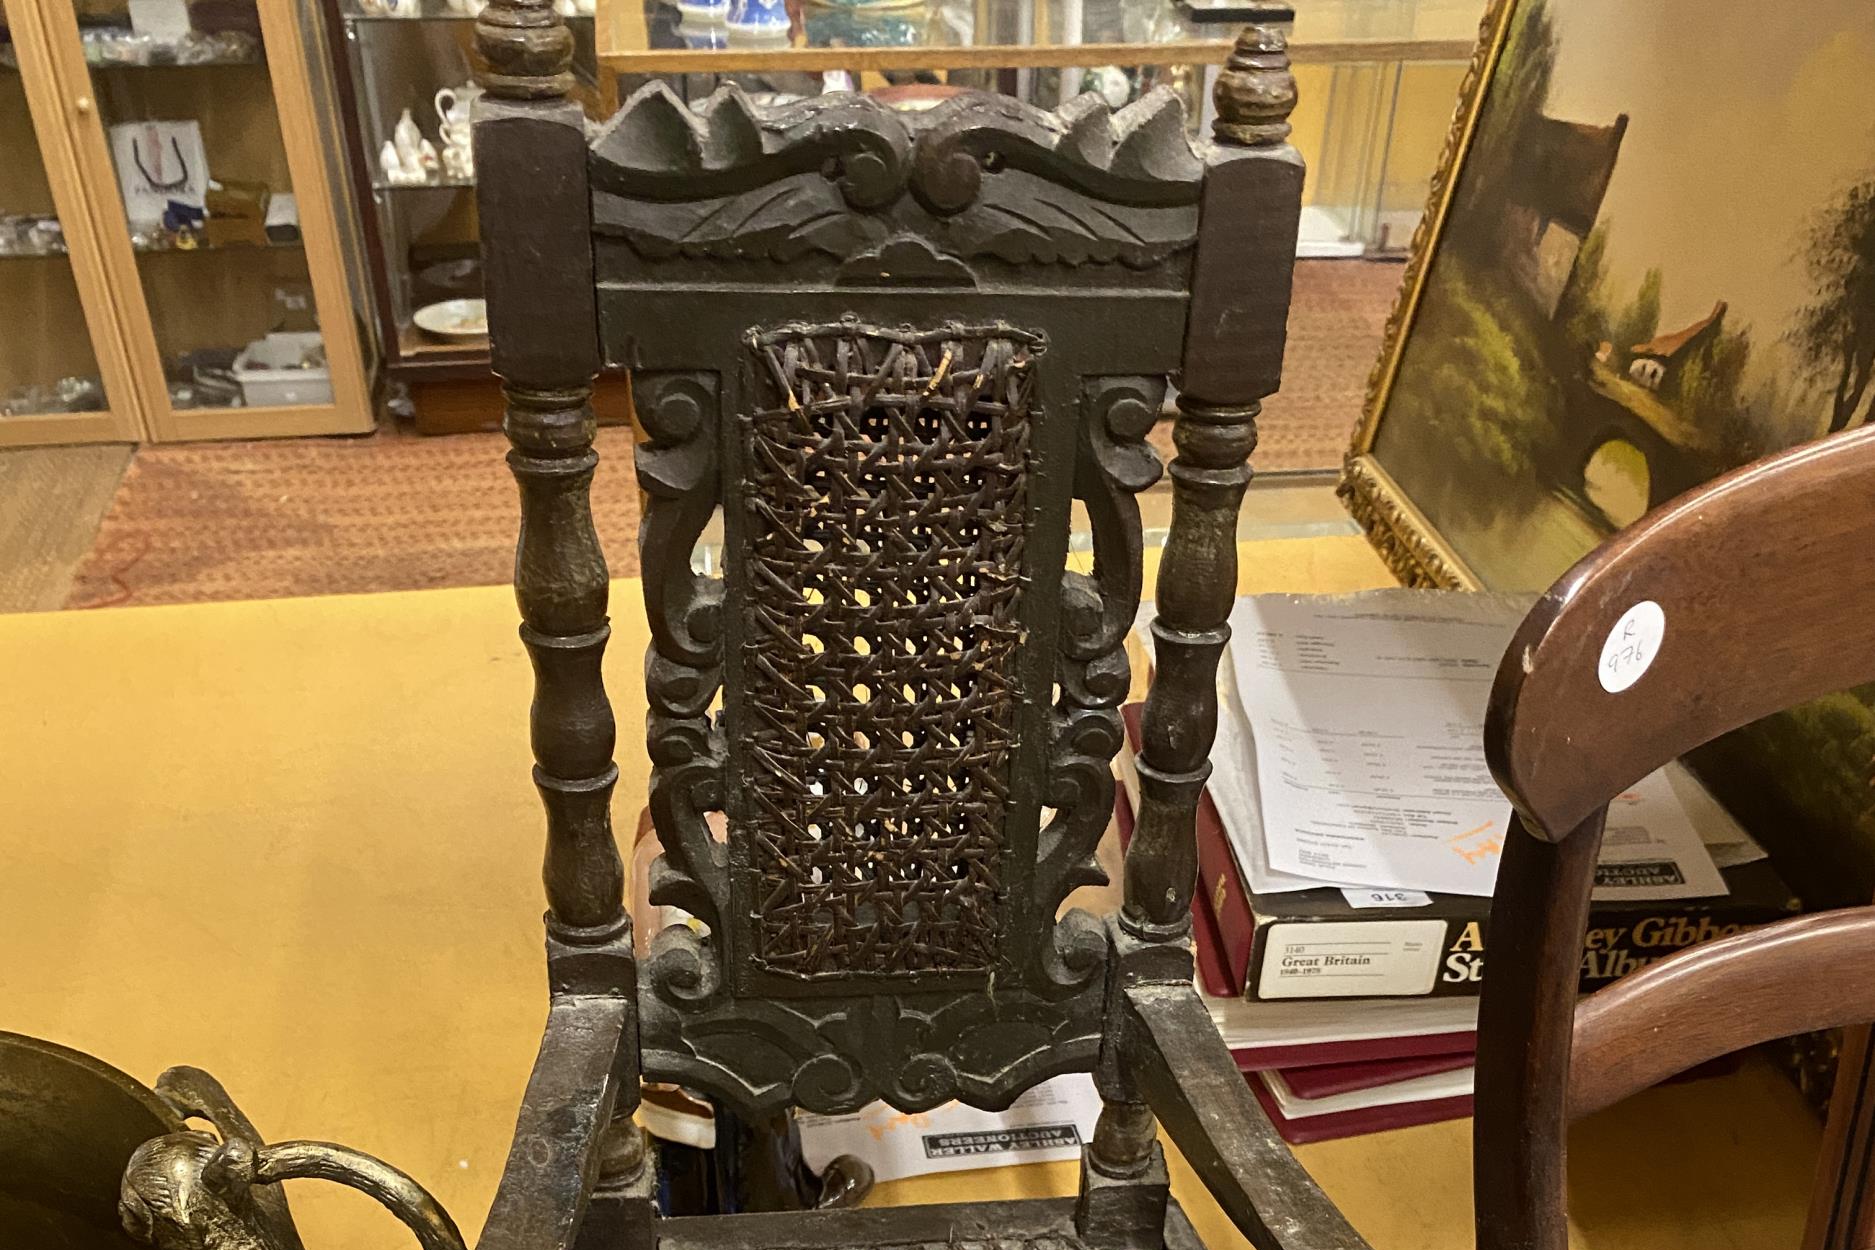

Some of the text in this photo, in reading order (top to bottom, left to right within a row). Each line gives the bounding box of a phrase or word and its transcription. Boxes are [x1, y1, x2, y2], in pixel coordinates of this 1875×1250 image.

[1608, 639, 1643, 673] 976
[1603, 874, 1676, 885] ASHLEY
[1370, 892, 1409, 902] 316
[1632, 915, 1745, 948] Gibbo
[1281, 954, 1371, 967] Great Britain
[931, 1136, 1076, 1156] ASHLEY WALLER
[939, 1129, 1062, 1147] AUCTIONEERS
